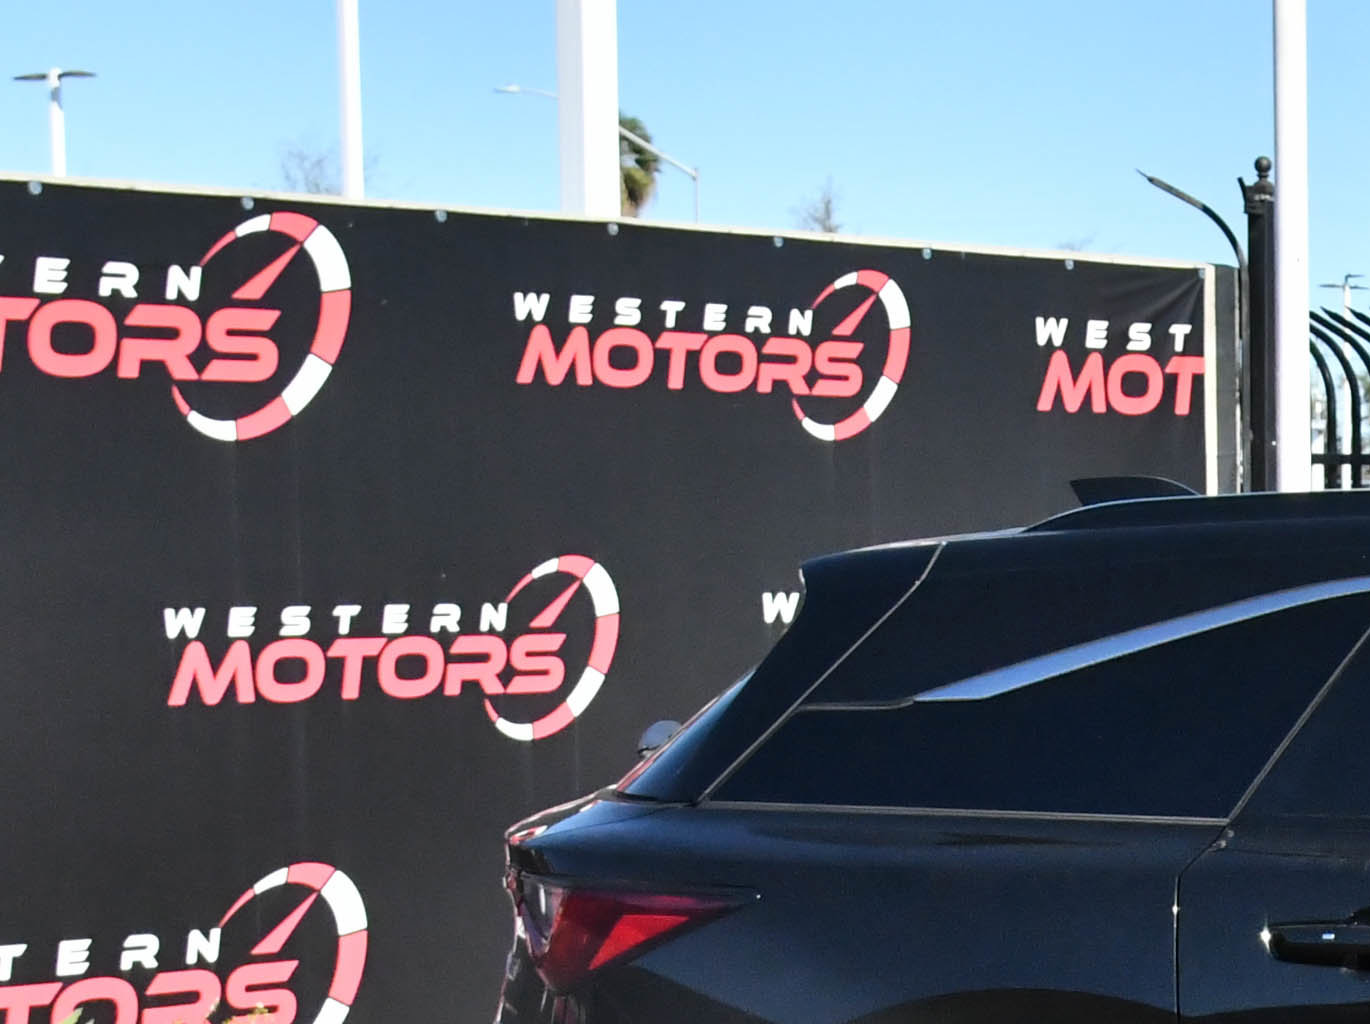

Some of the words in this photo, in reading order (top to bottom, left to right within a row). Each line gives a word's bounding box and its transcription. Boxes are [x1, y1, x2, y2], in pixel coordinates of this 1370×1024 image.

[0, 254, 203, 302] ERN
[513, 291, 814, 337] WESTERN
[1035, 316, 1193, 353] WEST
[515, 323, 865, 399] MOTORS
[163, 602, 508, 640] WESTERN
[167, 633, 567, 707] MOTORS
